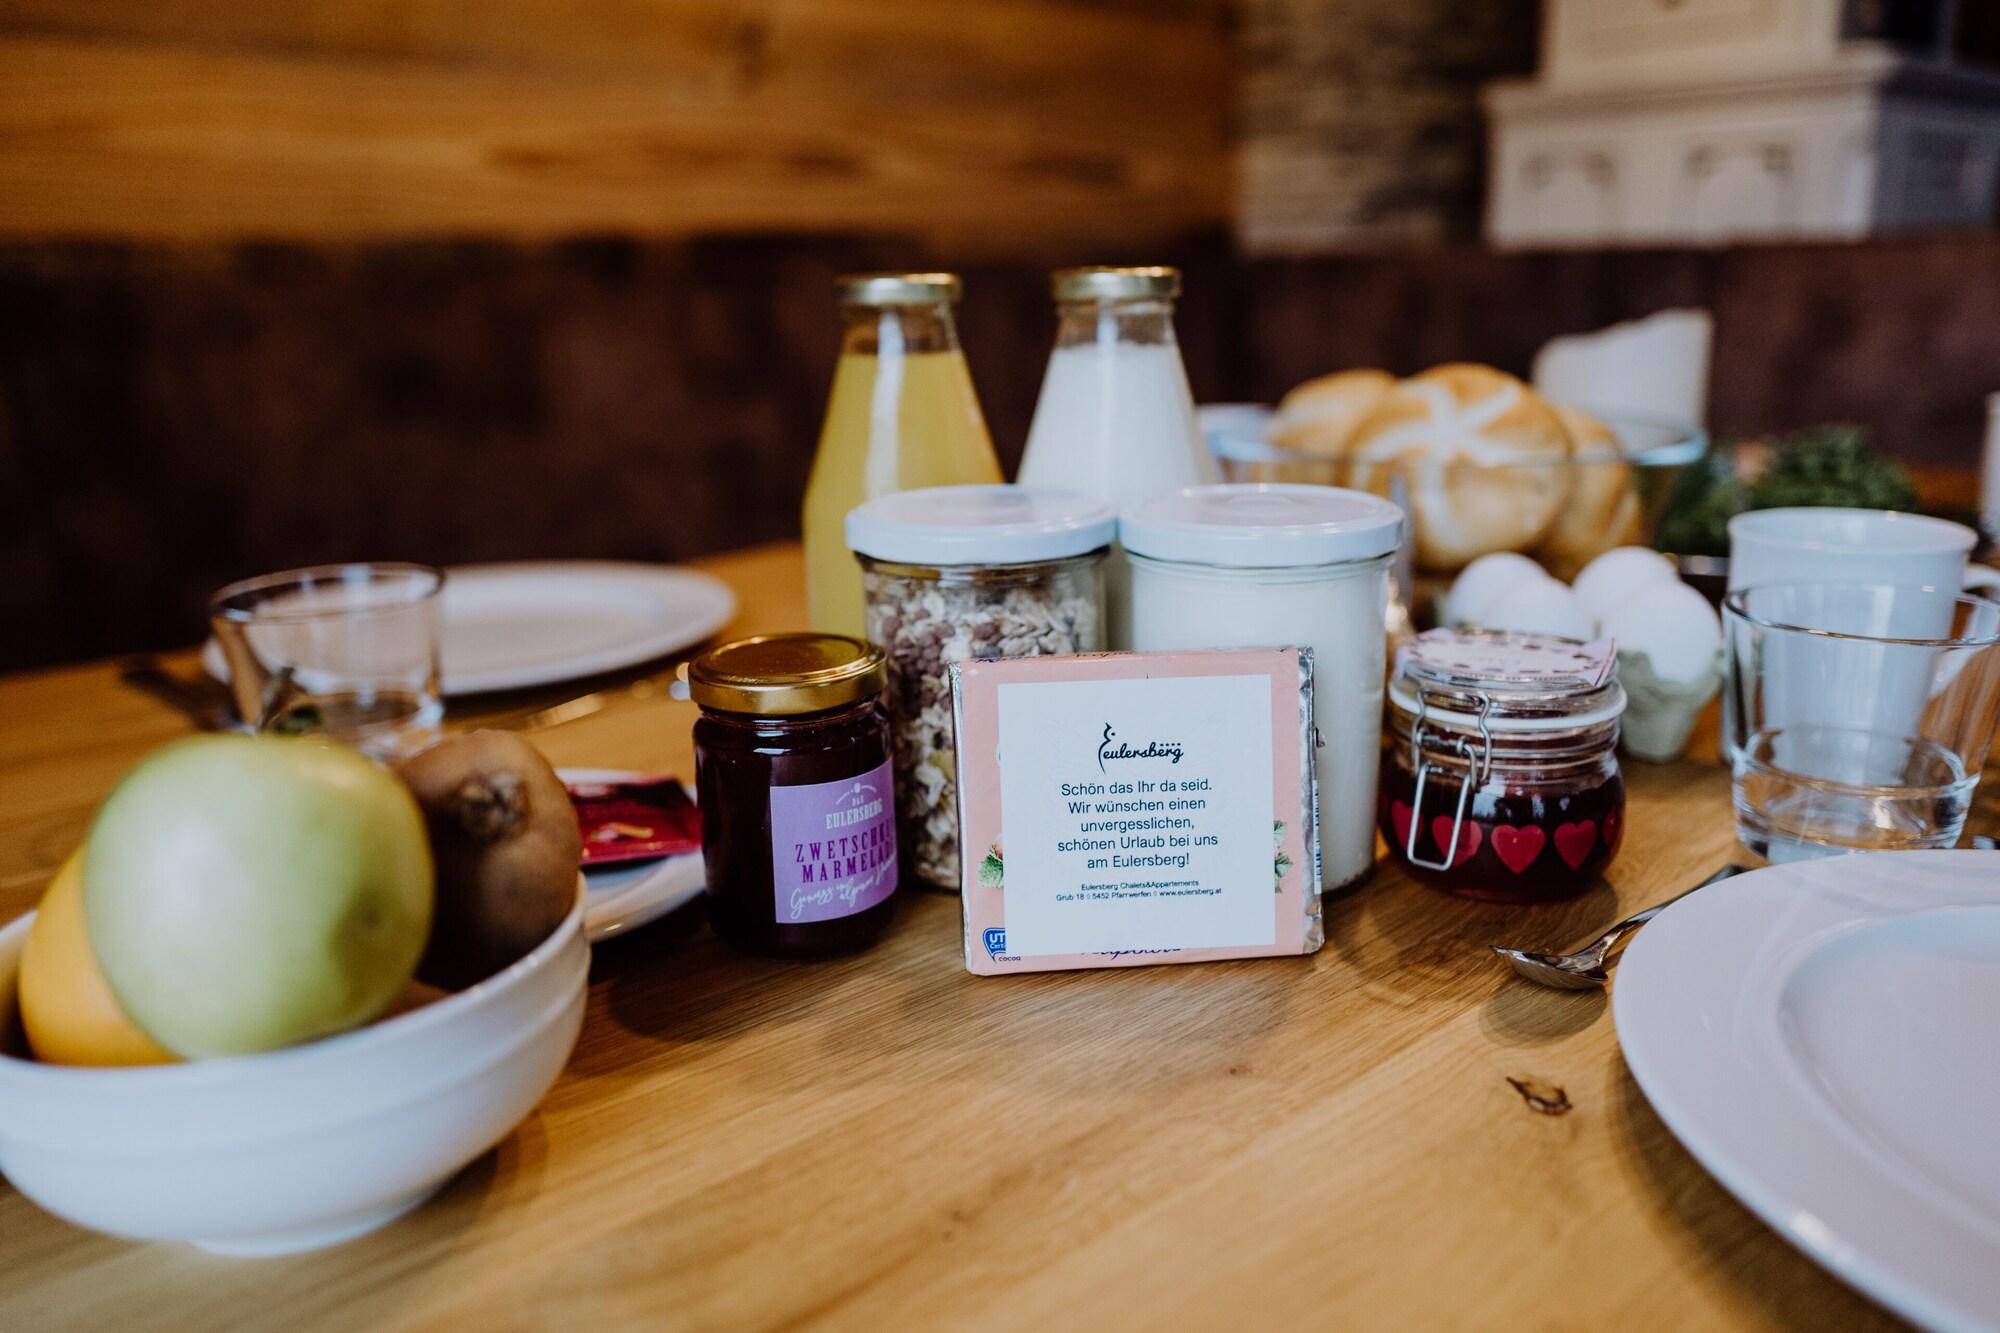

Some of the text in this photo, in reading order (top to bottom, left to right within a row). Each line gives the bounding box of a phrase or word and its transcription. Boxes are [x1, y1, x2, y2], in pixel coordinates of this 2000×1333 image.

[1061, 778, 1212, 796] Schön das Ihr da seid.
[1068, 798, 1206, 814] Wir wünschen einen
[1081, 817, 1195, 833] unvergesslichen,
[1057, 835, 1218, 851] schönen Urlaub bei uns
[1087, 853, 1190, 869] am Eulersberg!
[1081, 883, 1119, 891] Eulersberg
[1092, 891, 1110, 899] 5452
